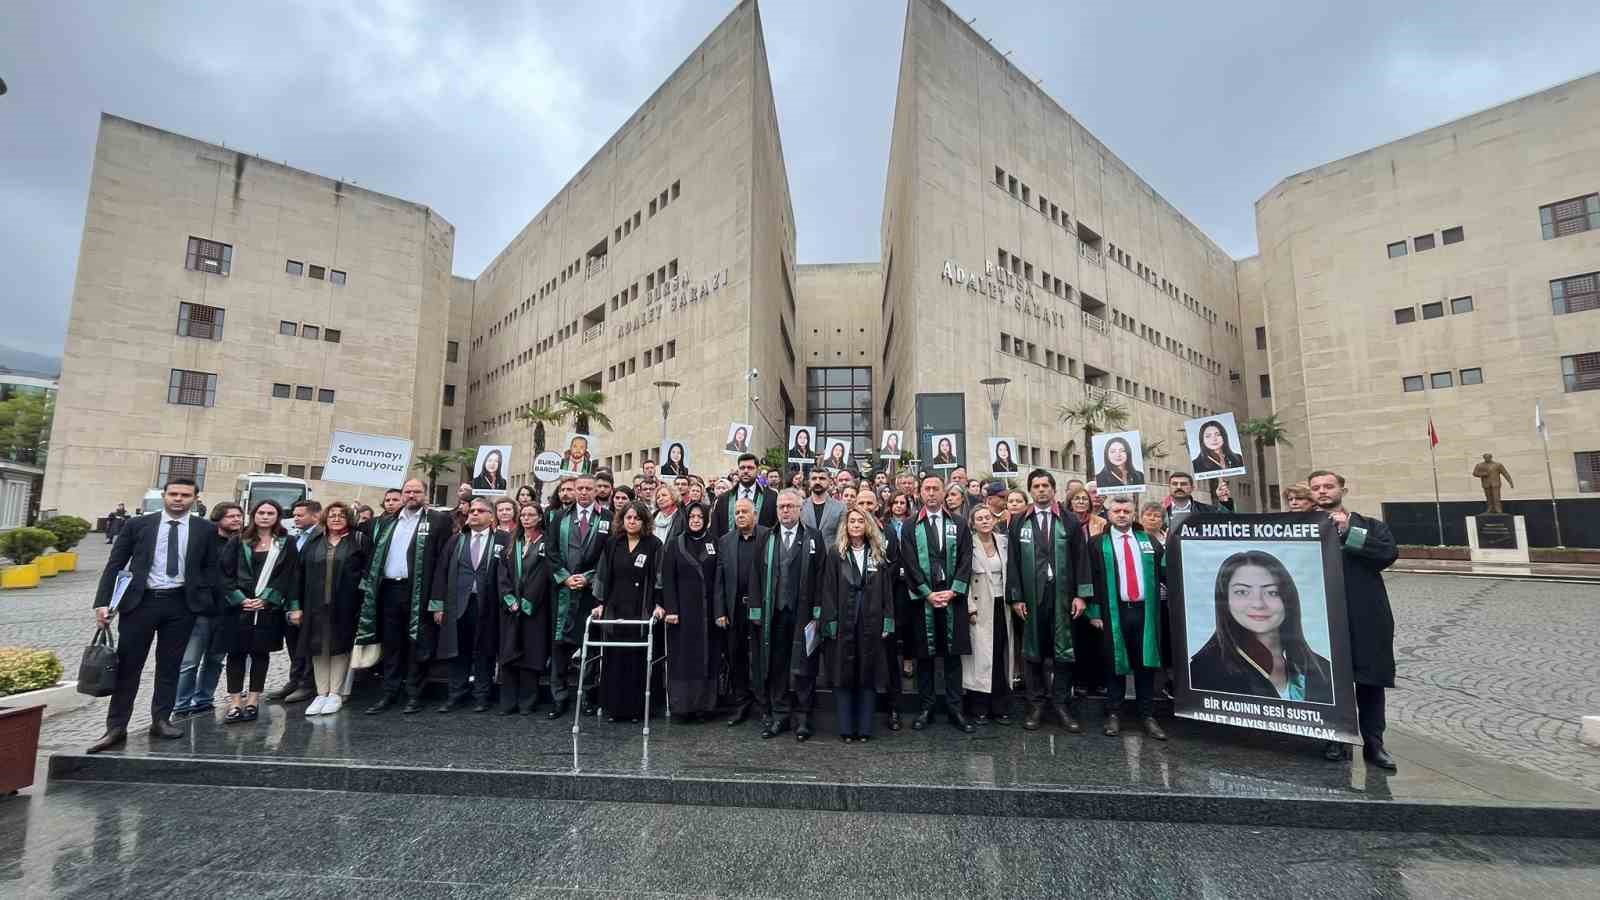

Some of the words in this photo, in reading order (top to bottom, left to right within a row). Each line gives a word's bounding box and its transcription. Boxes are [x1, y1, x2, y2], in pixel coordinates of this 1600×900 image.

[338, 444, 403, 461] Savunmayı
[331, 455, 404, 472] Savunuyoruz
[1181, 524, 1199, 537] Av.
[1202, 520, 1251, 538] HATİCE
[1254, 523, 1320, 538] KOCAEFE
[1204, 697, 1220, 710] BİR
[1221, 700, 1261, 715] KADININ
[1262, 704, 1285, 718] SESİ
[1286, 708, 1324, 725] SUSTU,
